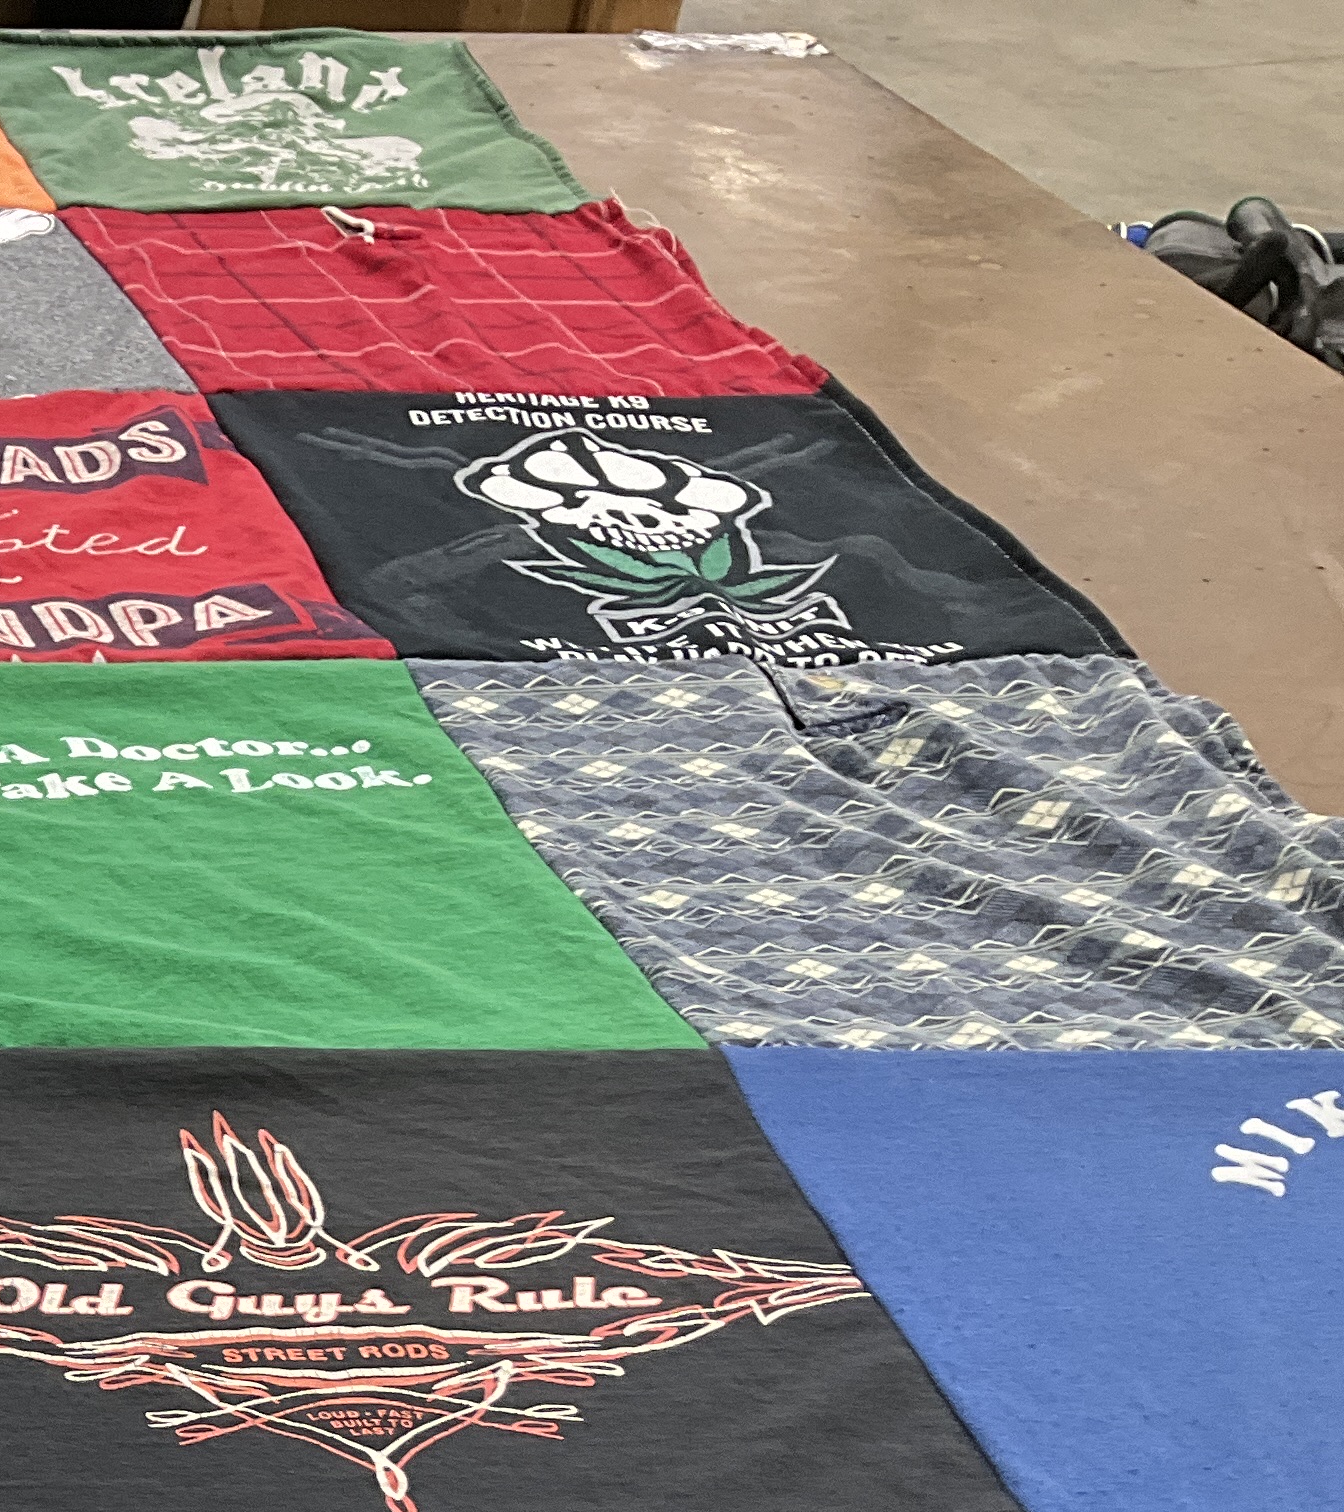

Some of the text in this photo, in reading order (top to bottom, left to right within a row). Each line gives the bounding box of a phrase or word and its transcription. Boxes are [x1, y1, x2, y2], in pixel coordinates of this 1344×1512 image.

[409, 405, 713, 434] DETECTION COURSE
[151, 770, 213, 792] A
[218, 764, 433, 794] Look.
[169, 1277, 410, 1323] Guys
[434, 1276, 663, 1312] Rule
[222, 1341, 449, 1364] STREET RODS
[306, 1409, 424, 1420] LOUD FAST
[330, 1419, 413, 1429] BUILT TO
[349, 1427, 395, 1436] LAST
